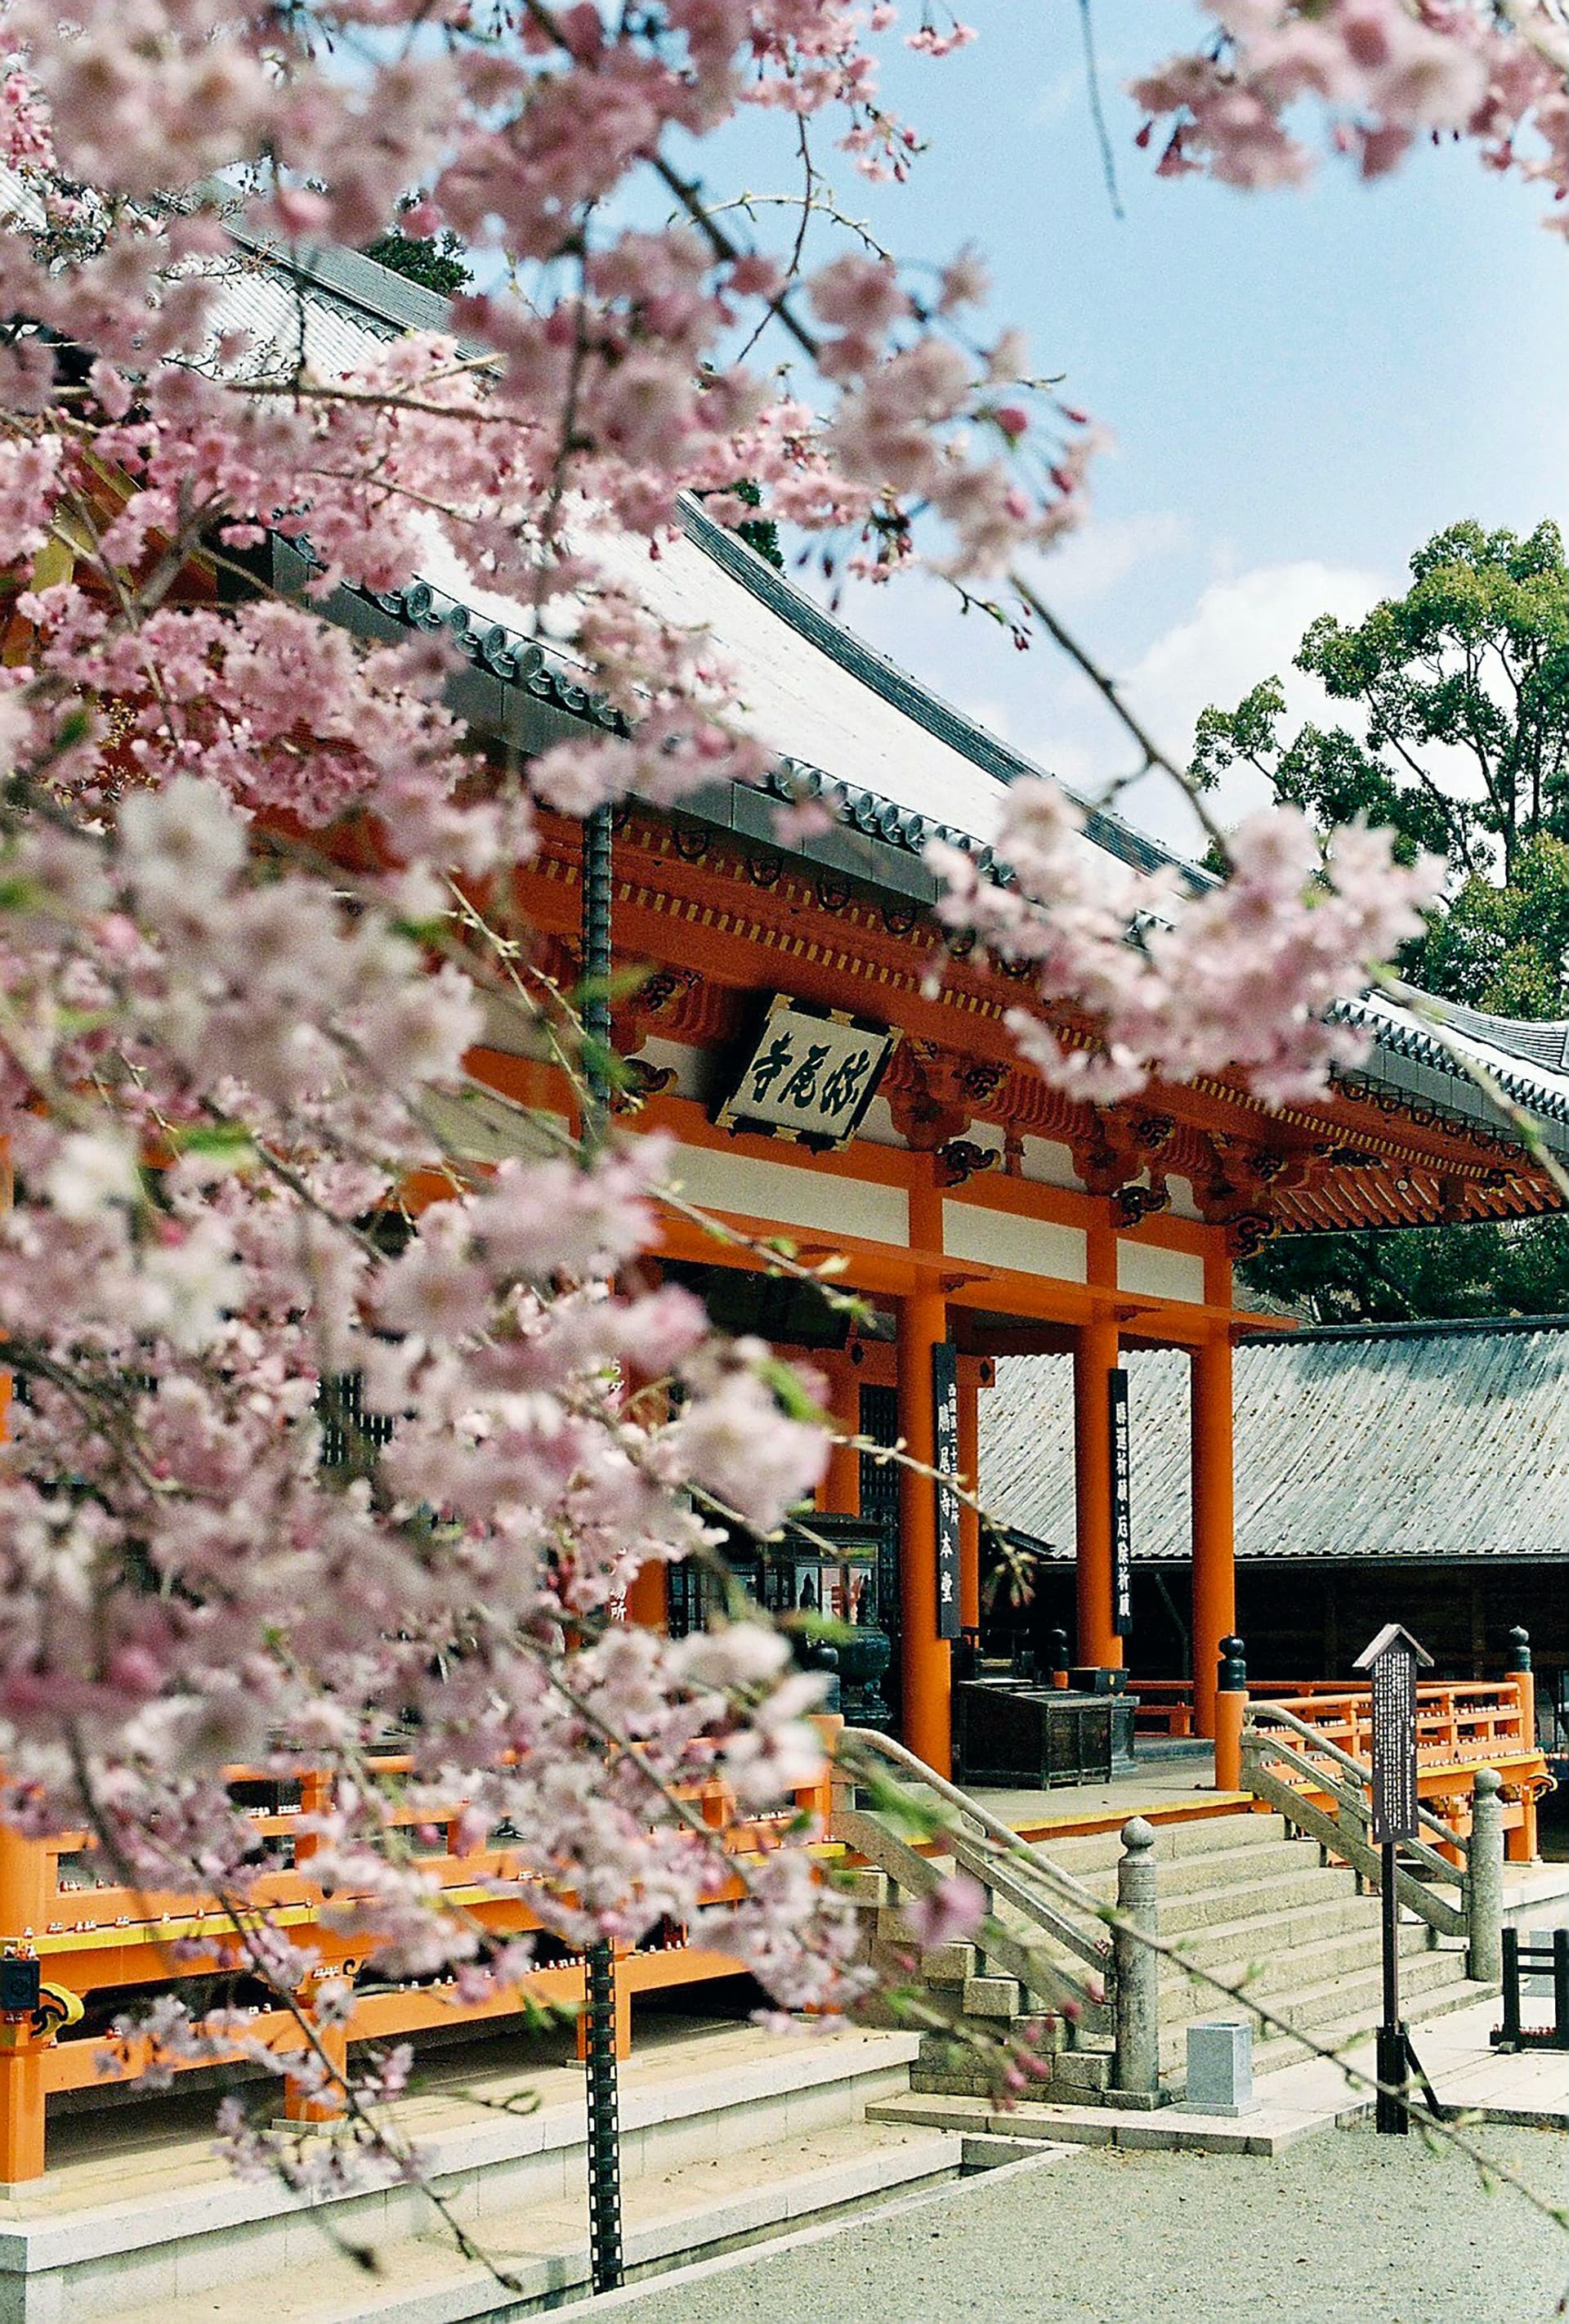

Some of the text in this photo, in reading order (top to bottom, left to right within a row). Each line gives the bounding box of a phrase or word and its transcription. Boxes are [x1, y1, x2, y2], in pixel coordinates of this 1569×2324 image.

[938, 1403, 954, 1604] 勝尾寺本堂
